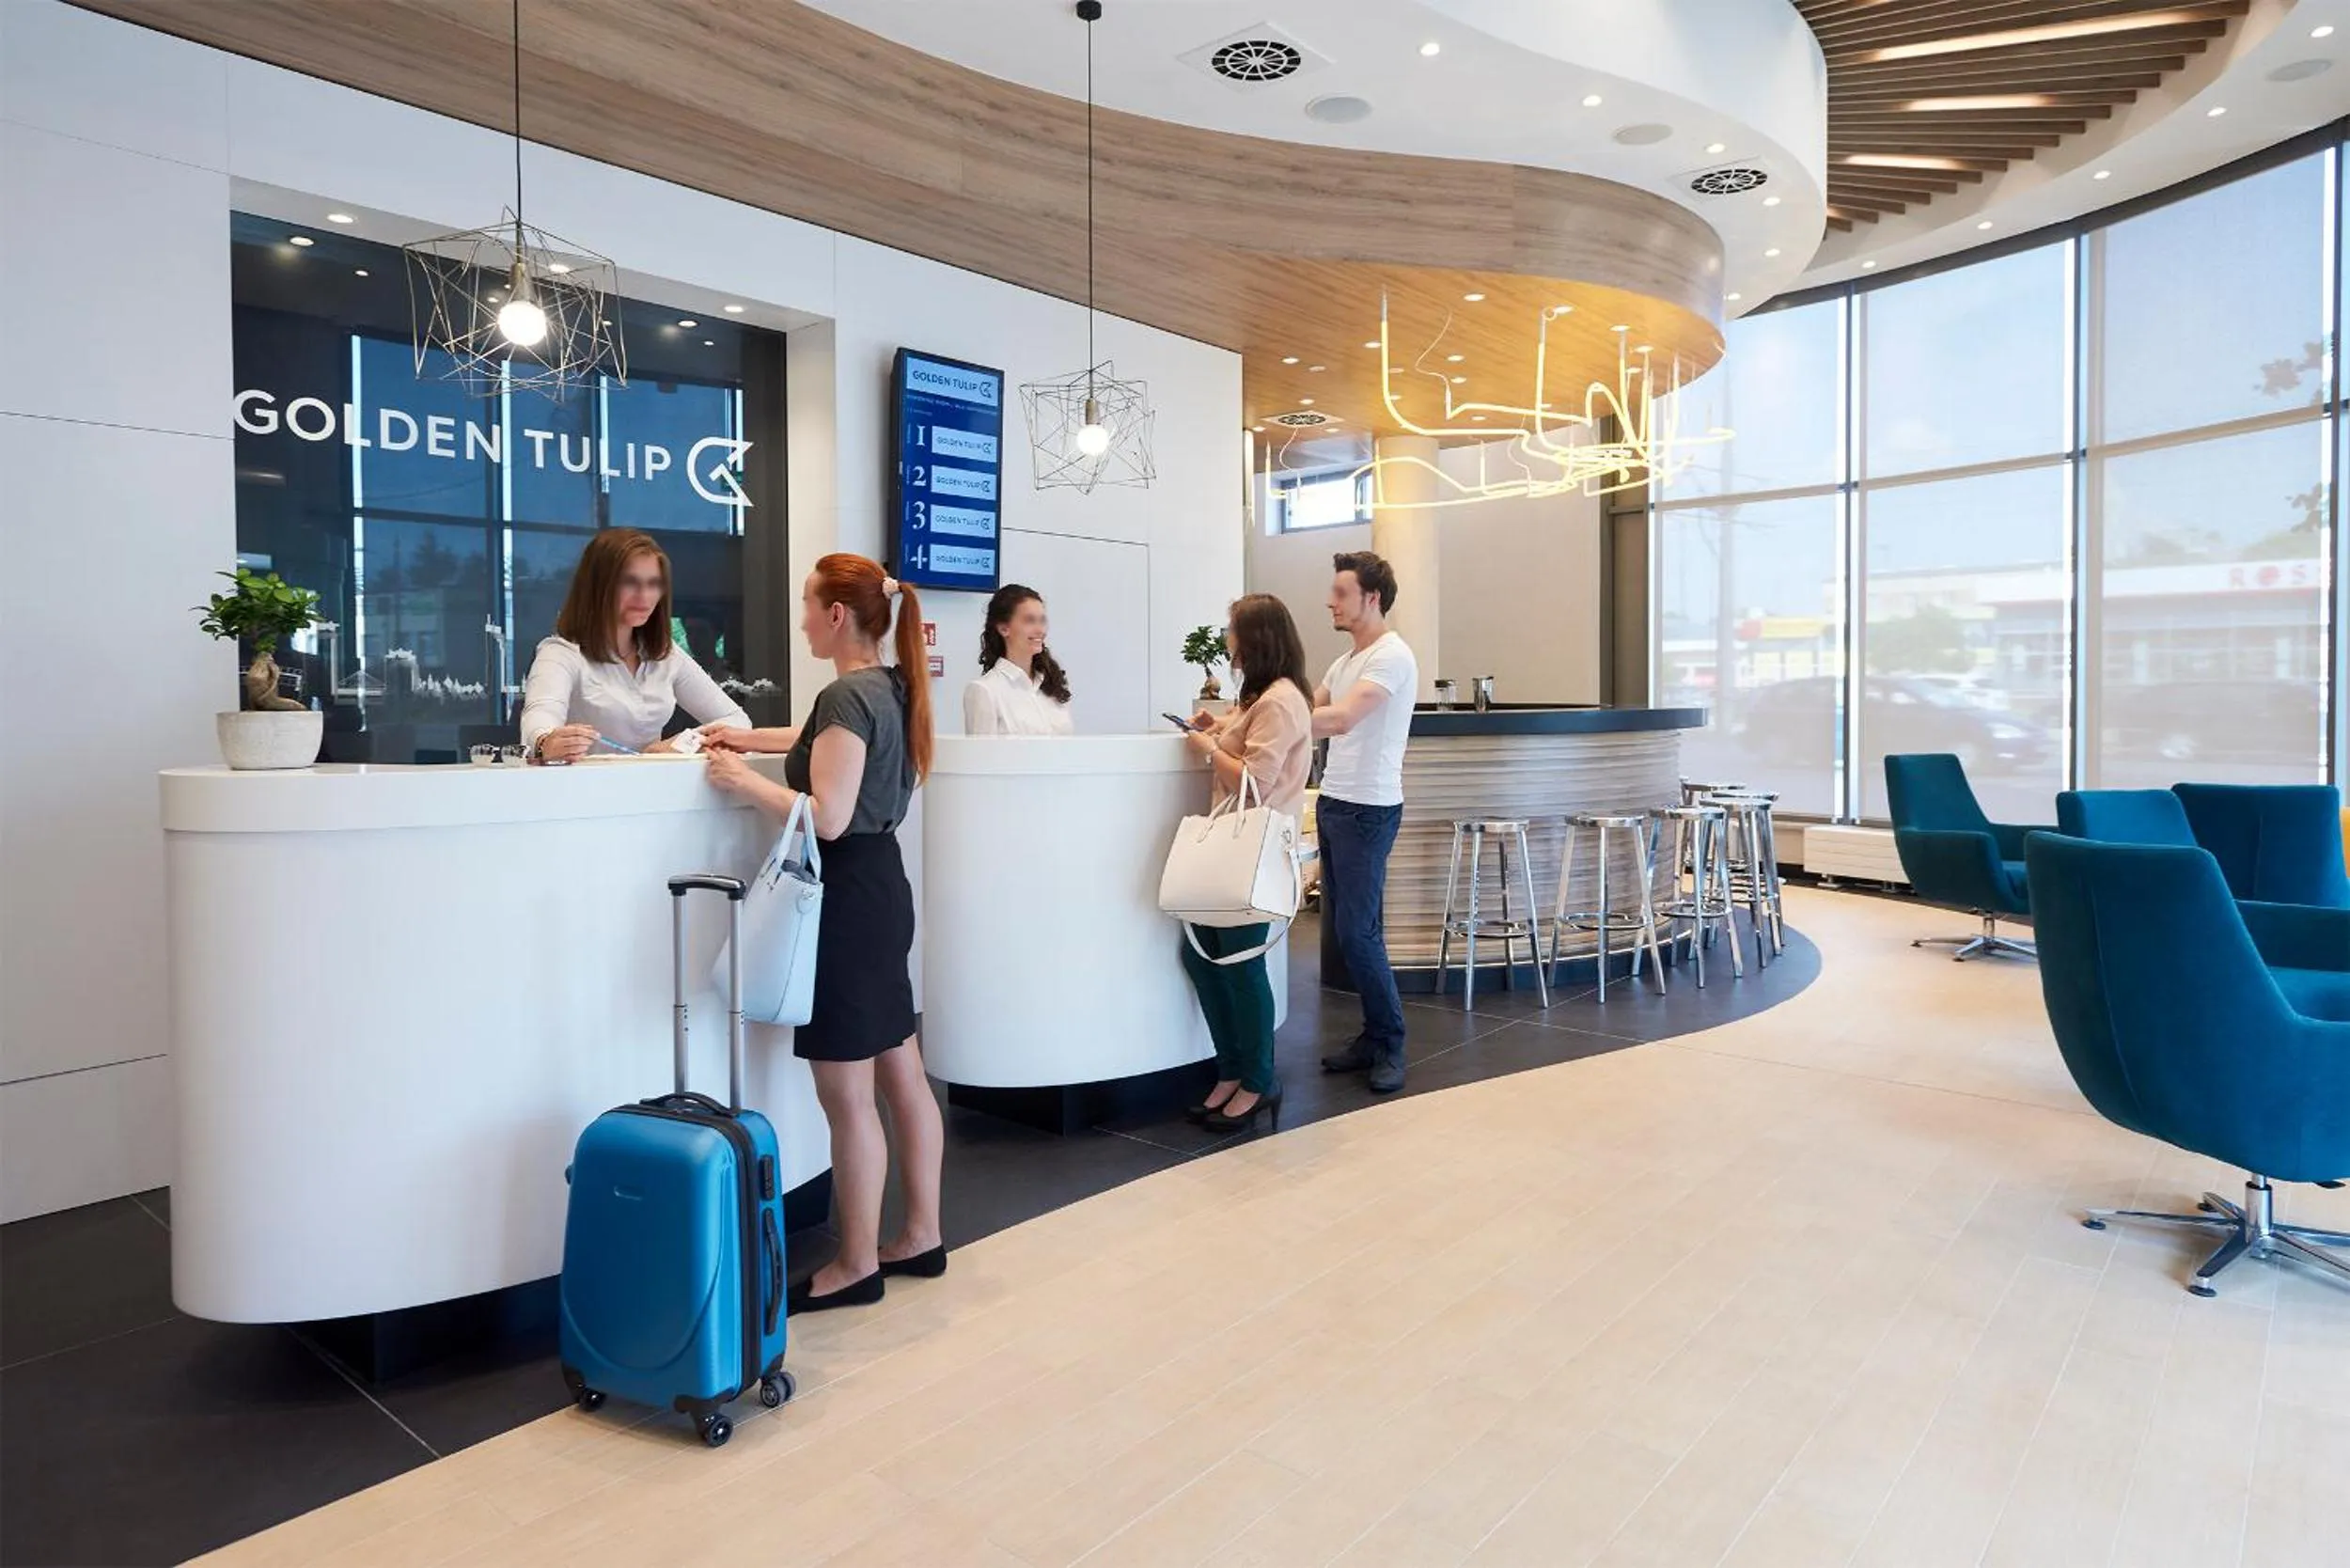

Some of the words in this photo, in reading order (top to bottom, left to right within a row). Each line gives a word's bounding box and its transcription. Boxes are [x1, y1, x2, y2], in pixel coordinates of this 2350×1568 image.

[912, 370, 950, 386] GOLDEN
[951, 378, 978, 391] TULIP
[233, 388, 501, 463] GOLDEN
[523, 429, 671, 481] TULIP
[912, 465, 927, 487] 2
[912, 500, 926, 529] 3
[909, 543, 929, 570] 4
